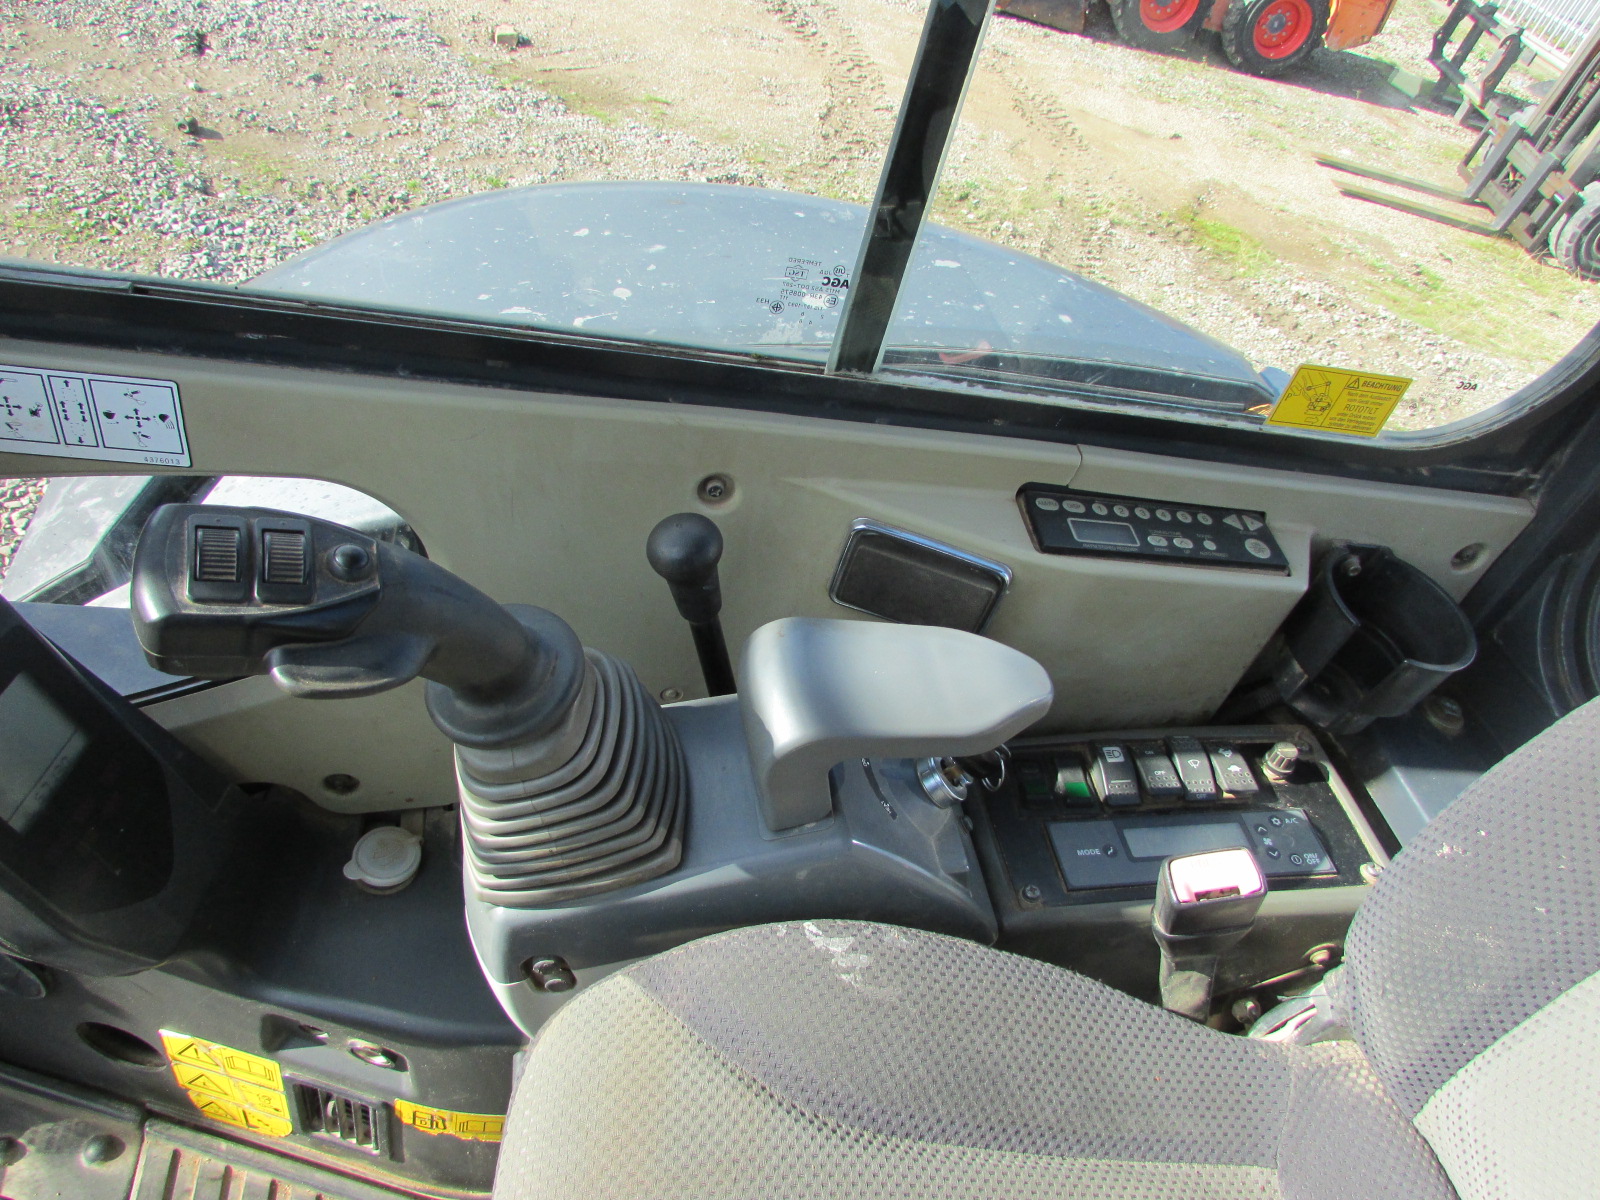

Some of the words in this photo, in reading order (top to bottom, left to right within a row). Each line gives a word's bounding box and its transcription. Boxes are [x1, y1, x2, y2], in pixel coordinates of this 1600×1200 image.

[1362, 380, 1403, 392] BEACHTUNG
[1343, 404, 1379, 414] ROTOTILT
[144, 456, 181, 465] 4376013
[1076, 848, 1101, 856] MODE
